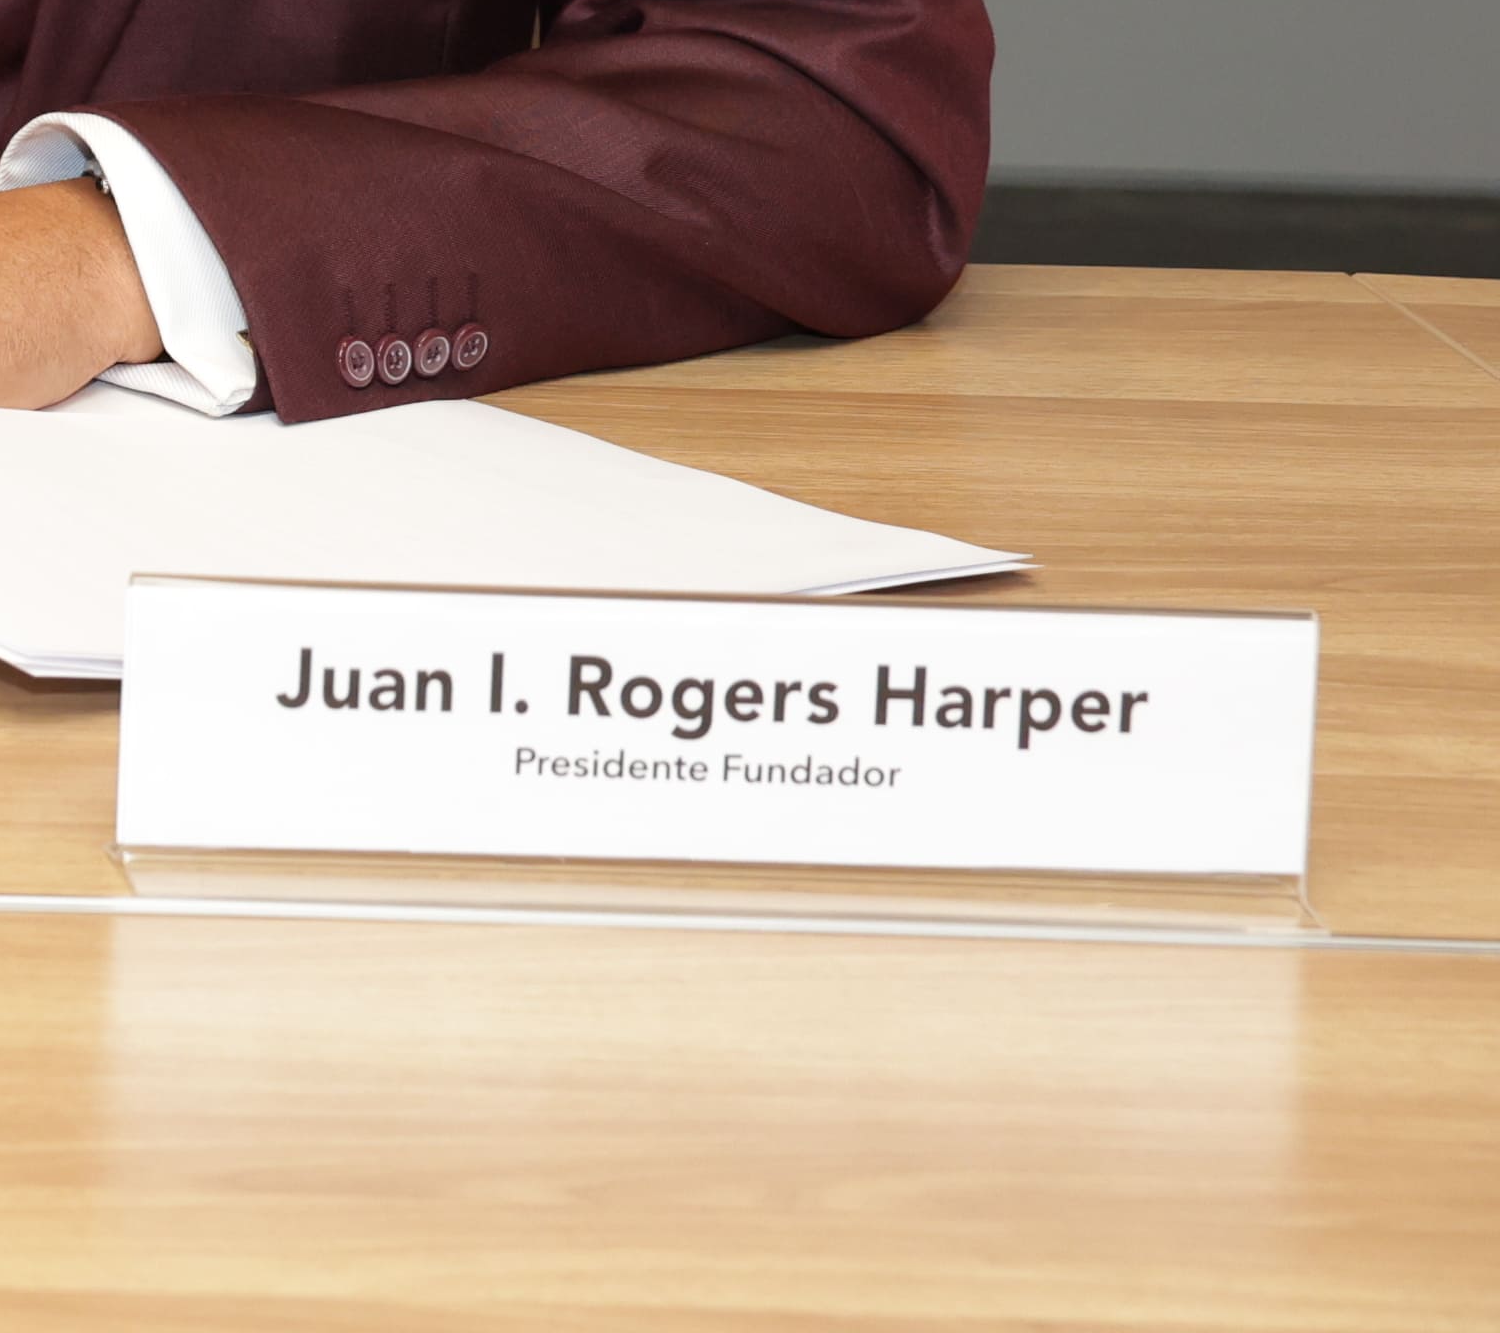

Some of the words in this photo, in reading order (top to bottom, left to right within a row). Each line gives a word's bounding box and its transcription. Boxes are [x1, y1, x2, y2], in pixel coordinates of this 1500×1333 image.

[275, 647, 455, 713] Juan
[488, 651, 530, 716] I.
[567, 654, 841, 741] Rogers
[873, 664, 1150, 751] Harper
[514, 747, 710, 783] Presidente
[721, 753, 902, 788] Fundador
